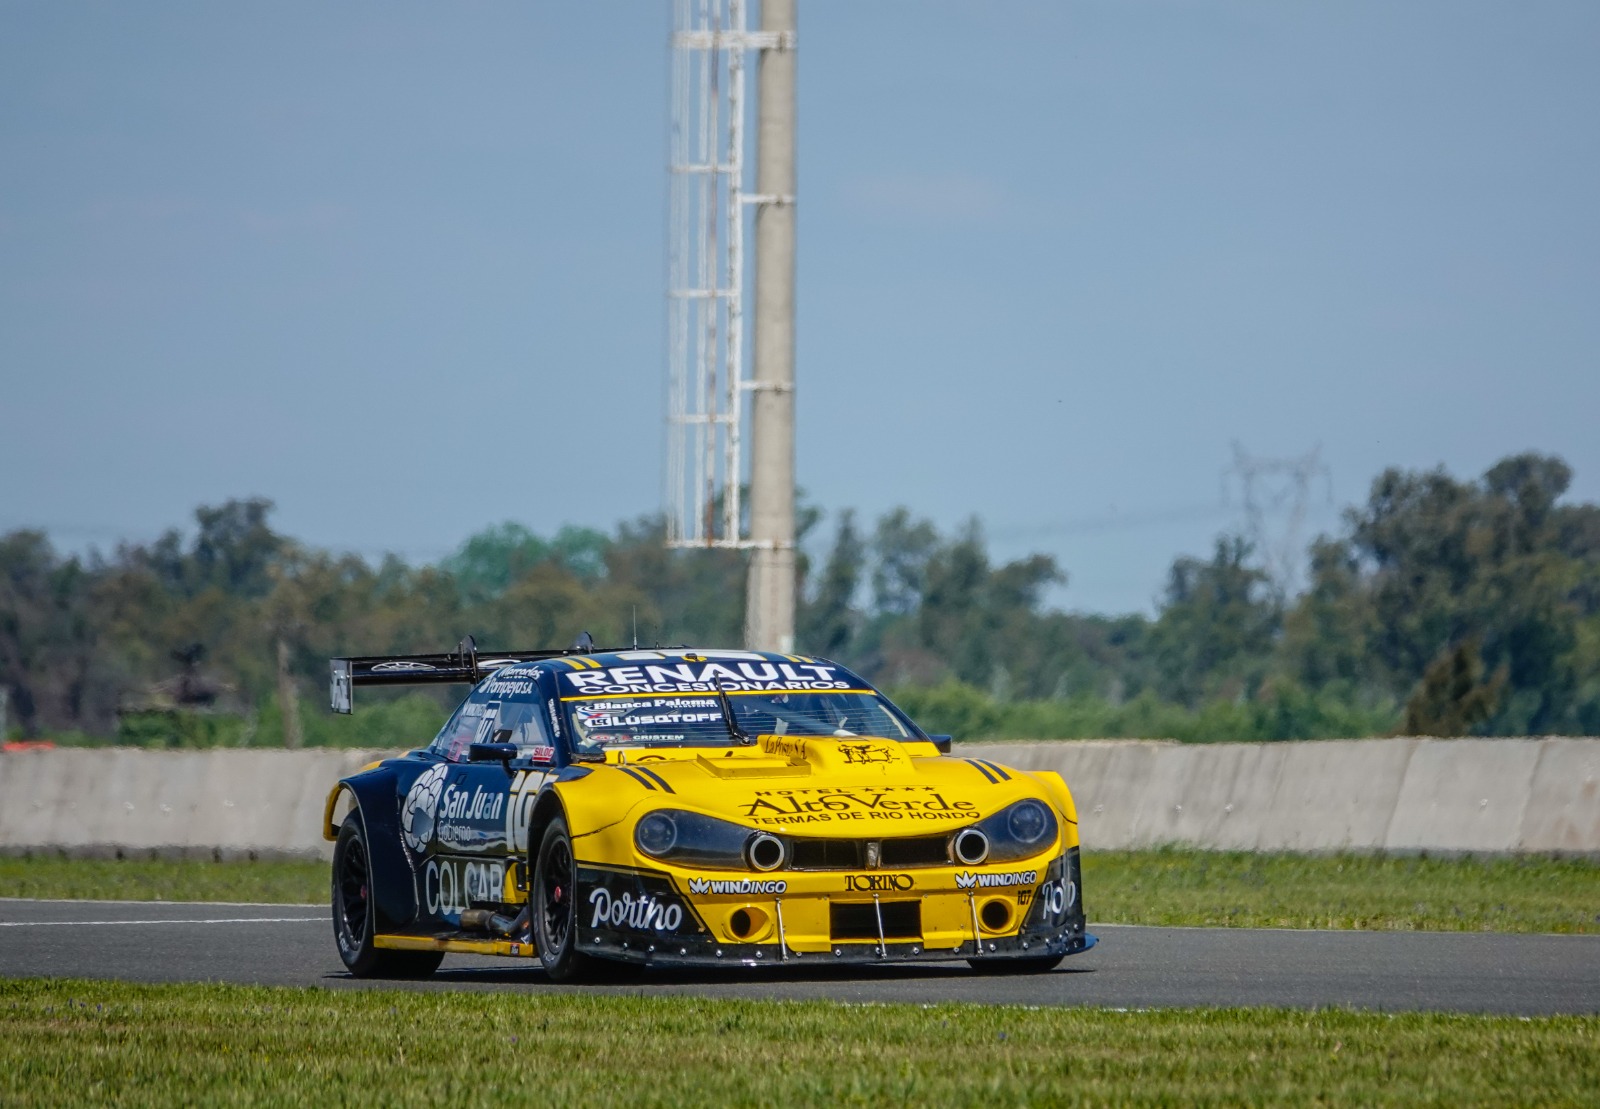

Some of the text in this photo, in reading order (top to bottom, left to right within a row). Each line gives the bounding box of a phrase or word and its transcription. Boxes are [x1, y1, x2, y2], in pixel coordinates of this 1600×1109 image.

[565, 663, 836, 687] RENAULT
[579, 680, 850, 694] CONCESIONARIOS
[593, 698, 716, 711] Blanca Paloma
[755, 788, 851, 796] HOTEL
[437, 783, 504, 820] San Juan
[748, 809, 982, 825] TERMAS DE RIO HONDO
[437, 820, 472, 842] Gobierno
[711, 880, 787, 895] WINDINGO
[844, 872, 915, 892] TORINO
[977, 870, 1038, 888] WINDINGO
